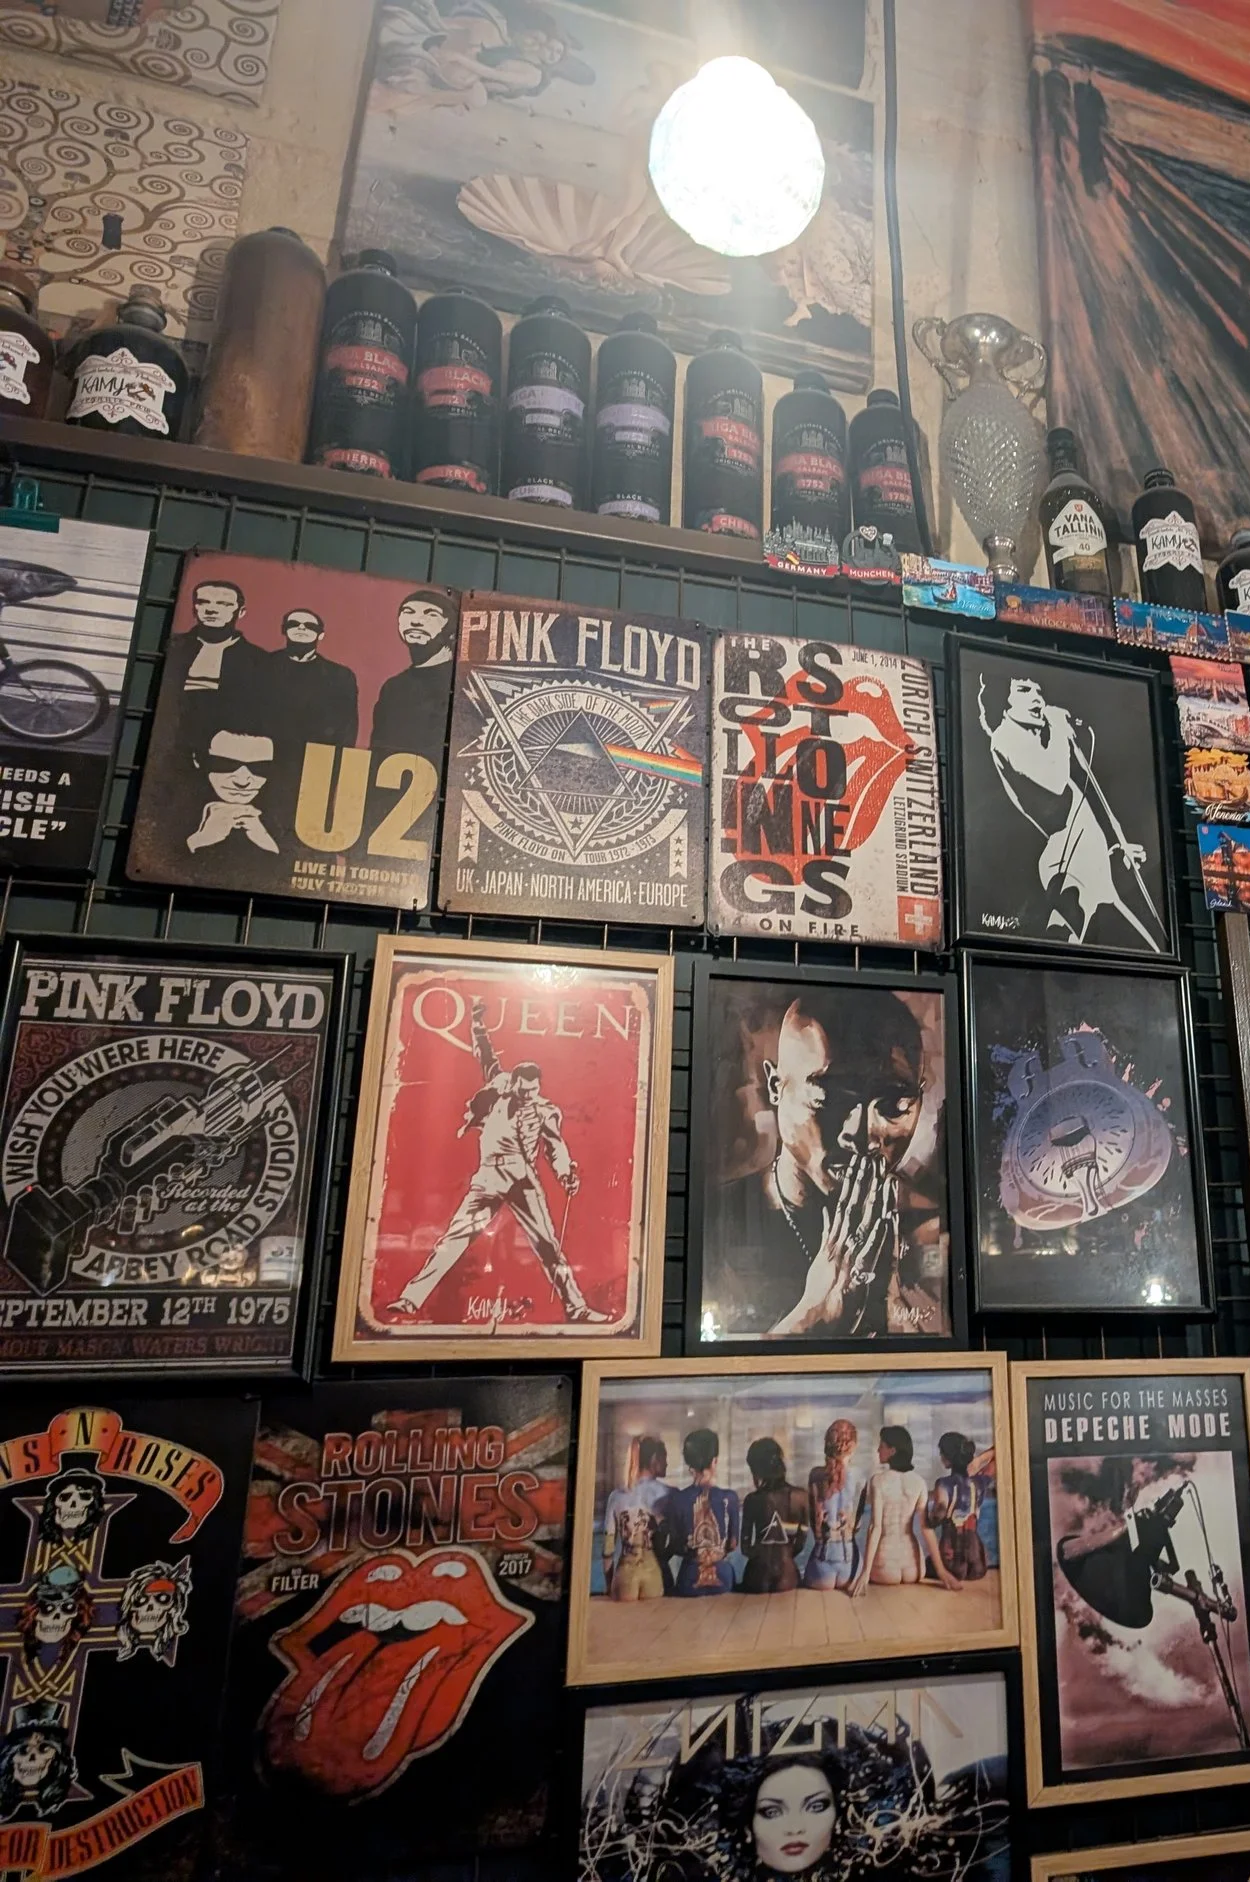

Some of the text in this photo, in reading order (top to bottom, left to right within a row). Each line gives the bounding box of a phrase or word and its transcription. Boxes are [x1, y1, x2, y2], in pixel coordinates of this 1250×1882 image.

[1054, 522, 1104, 541] TALLINN
[1064, 513, 1095, 524] VANA
[1078, 543, 1091, 551] 40
[777, 561, 827, 575] GERMANY
[459, 610, 701, 691] PINK FLOYD
[731, 636, 772, 651] THE
[852, 651, 868, 663] JUNE
[880, 656, 898, 668] 2014
[508, 693, 651, 741] THE DARK SIDE OF THE MOON
[0, 766, 71, 786] EEDS A
[901, 660, 939, 897] ZURICH SWITZERLAND
[0, 788, 57, 814] ISH
[294, 742, 438, 861] U2
[493, 821, 517, 842] PINK
[517, 834, 548, 857] FLOYD
[551, 850, 566, 861] ON
[584, 852, 607, 863] TOUR
[609, 847, 629, 859] 1972
[893, 796, 909, 893] LETZIGRUND STADIUM
[293, 861, 327, 876] LIVE
[329, 865, 346, 877] IN
[291, 877, 324, 891] JULY
[530, 875, 573, 901] NORTH
[577, 878, 631, 904] AMERICA
[637, 882, 688, 908] EUROPE
[759, 918, 792, 932] ON
[808, 922, 859, 937] FIRE
[20, 969, 330, 1029] PINK FLOYD
[412, 987, 632, 1057] QUEEN
[5, 1038, 226, 1185] WISH YOU WERE HERE
[82, 1105, 296, 1281] ABBEY ROAD STUDIOS
[160, 1182, 252, 1200] Recorded
[184, 1199, 241, 1212] at the
[0, 1298, 148, 1328] PTEMBER
[227, 1296, 291, 1326] 1975
[132, 1336, 207, 1356] WATERS
[1044, 1388, 1228, 1412] MUSIC FOR THE MASSES
[1044, 1412, 1231, 1444] DEPECHE MODE
[321, 1426, 504, 1478] ROLLING
[113, 1436, 217, 1501] ROSES
[274, 1471, 539, 1555] STONES
[500, 1559, 532, 1576] 2017
[271, 1573, 319, 1592] FILTER
[51, 1768, 199, 1870] DESTRUCTION
